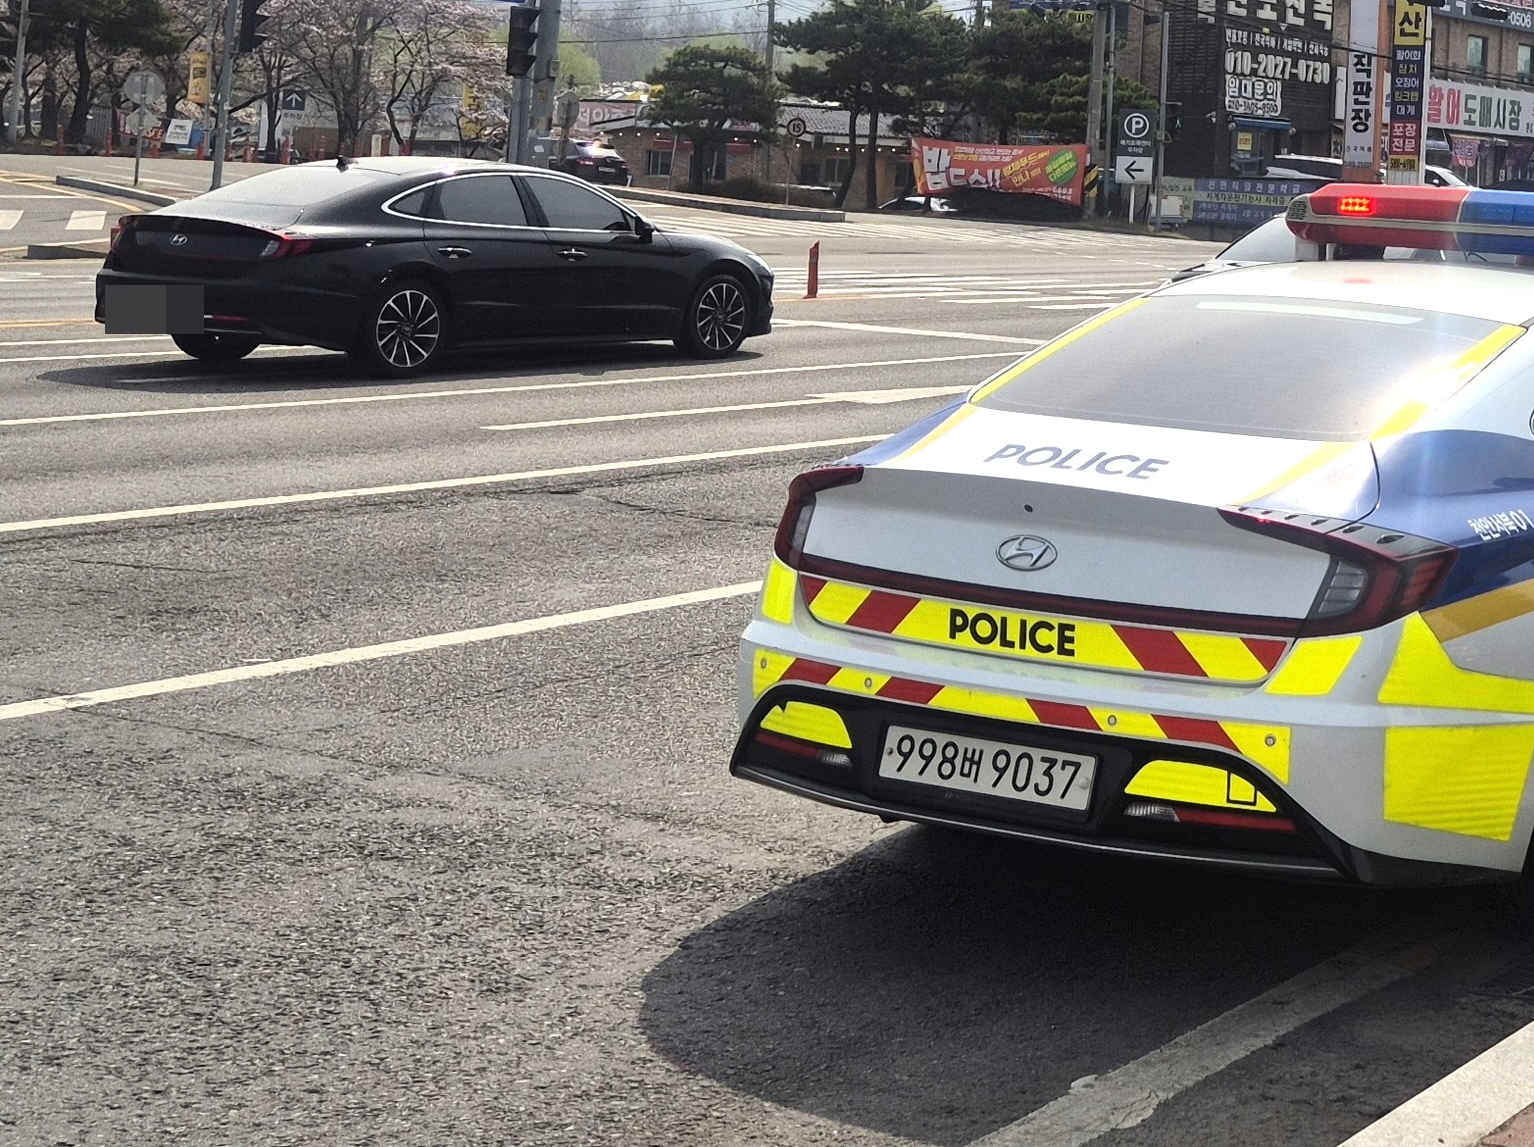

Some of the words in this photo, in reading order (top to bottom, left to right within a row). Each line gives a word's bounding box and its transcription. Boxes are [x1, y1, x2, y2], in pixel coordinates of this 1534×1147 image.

[1225, 51, 1330, 85] 010-2027-0730
[1395, 77, 1420, 88] 오징어
[1350, 54, 1372, 133] 직판장
[1392, 123, 1417, 136] 포장
[1392, 138, 1416, 152] 전문
[984, 443, 1170, 482] POLICE
[948, 607, 1076, 657] POLICE
[896, 733, 980, 783] 998버
[991, 751, 1082, 800] 9037
